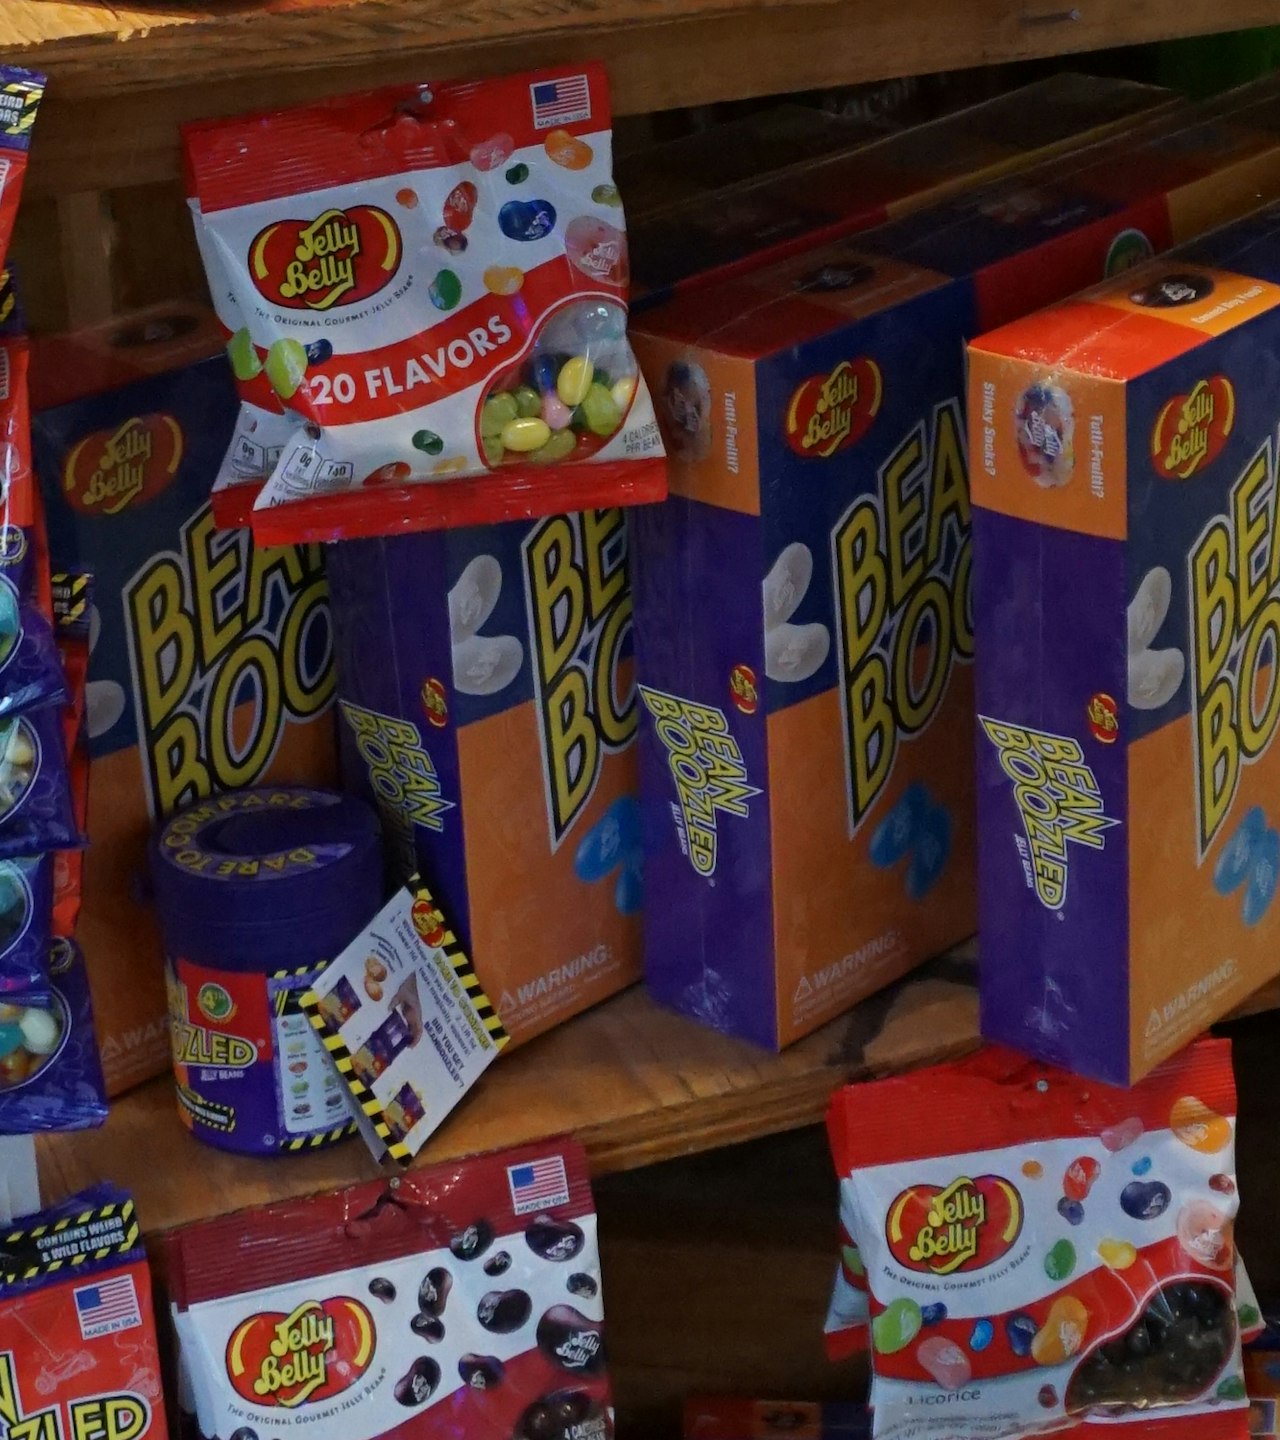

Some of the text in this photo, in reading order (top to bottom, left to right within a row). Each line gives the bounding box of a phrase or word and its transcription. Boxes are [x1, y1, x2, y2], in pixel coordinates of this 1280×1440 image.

[295, 218, 361, 262] Jelly
[280, 253, 356, 300] Belly
[274, 292, 394, 328] ORIGINAL GOURMET JELLY
[312, 315, 513, 407] 20 FLAVORS
[820, 370, 860, 412] Jelly
[1177, 382, 1217, 431] Jelly
[803, 405, 854, 447] Belly
[1165, 424, 1209, 473] Belly
[677, 693, 764, 818] BEAN
[638, 683, 718, 877] BOOZLED
[1030, 722, 1122, 851] BEAN
[978, 714, 1069, 911] BOOZLED
[927, 1191, 986, 1228] Jelly
[36, 1226, 89, 1252] CONTAINS
[52, 1231, 125, 1261] WILD FLAVORS
[910, 1220, 977, 1264] Belly
[84, 1324, 109, 1339] MADE
[270, 1311, 335, 1358] Jelly
[253, 1348, 327, 1396] Belly
[227, 1388, 366, 1426] THE ORIGINAL GOURMET JELLY
